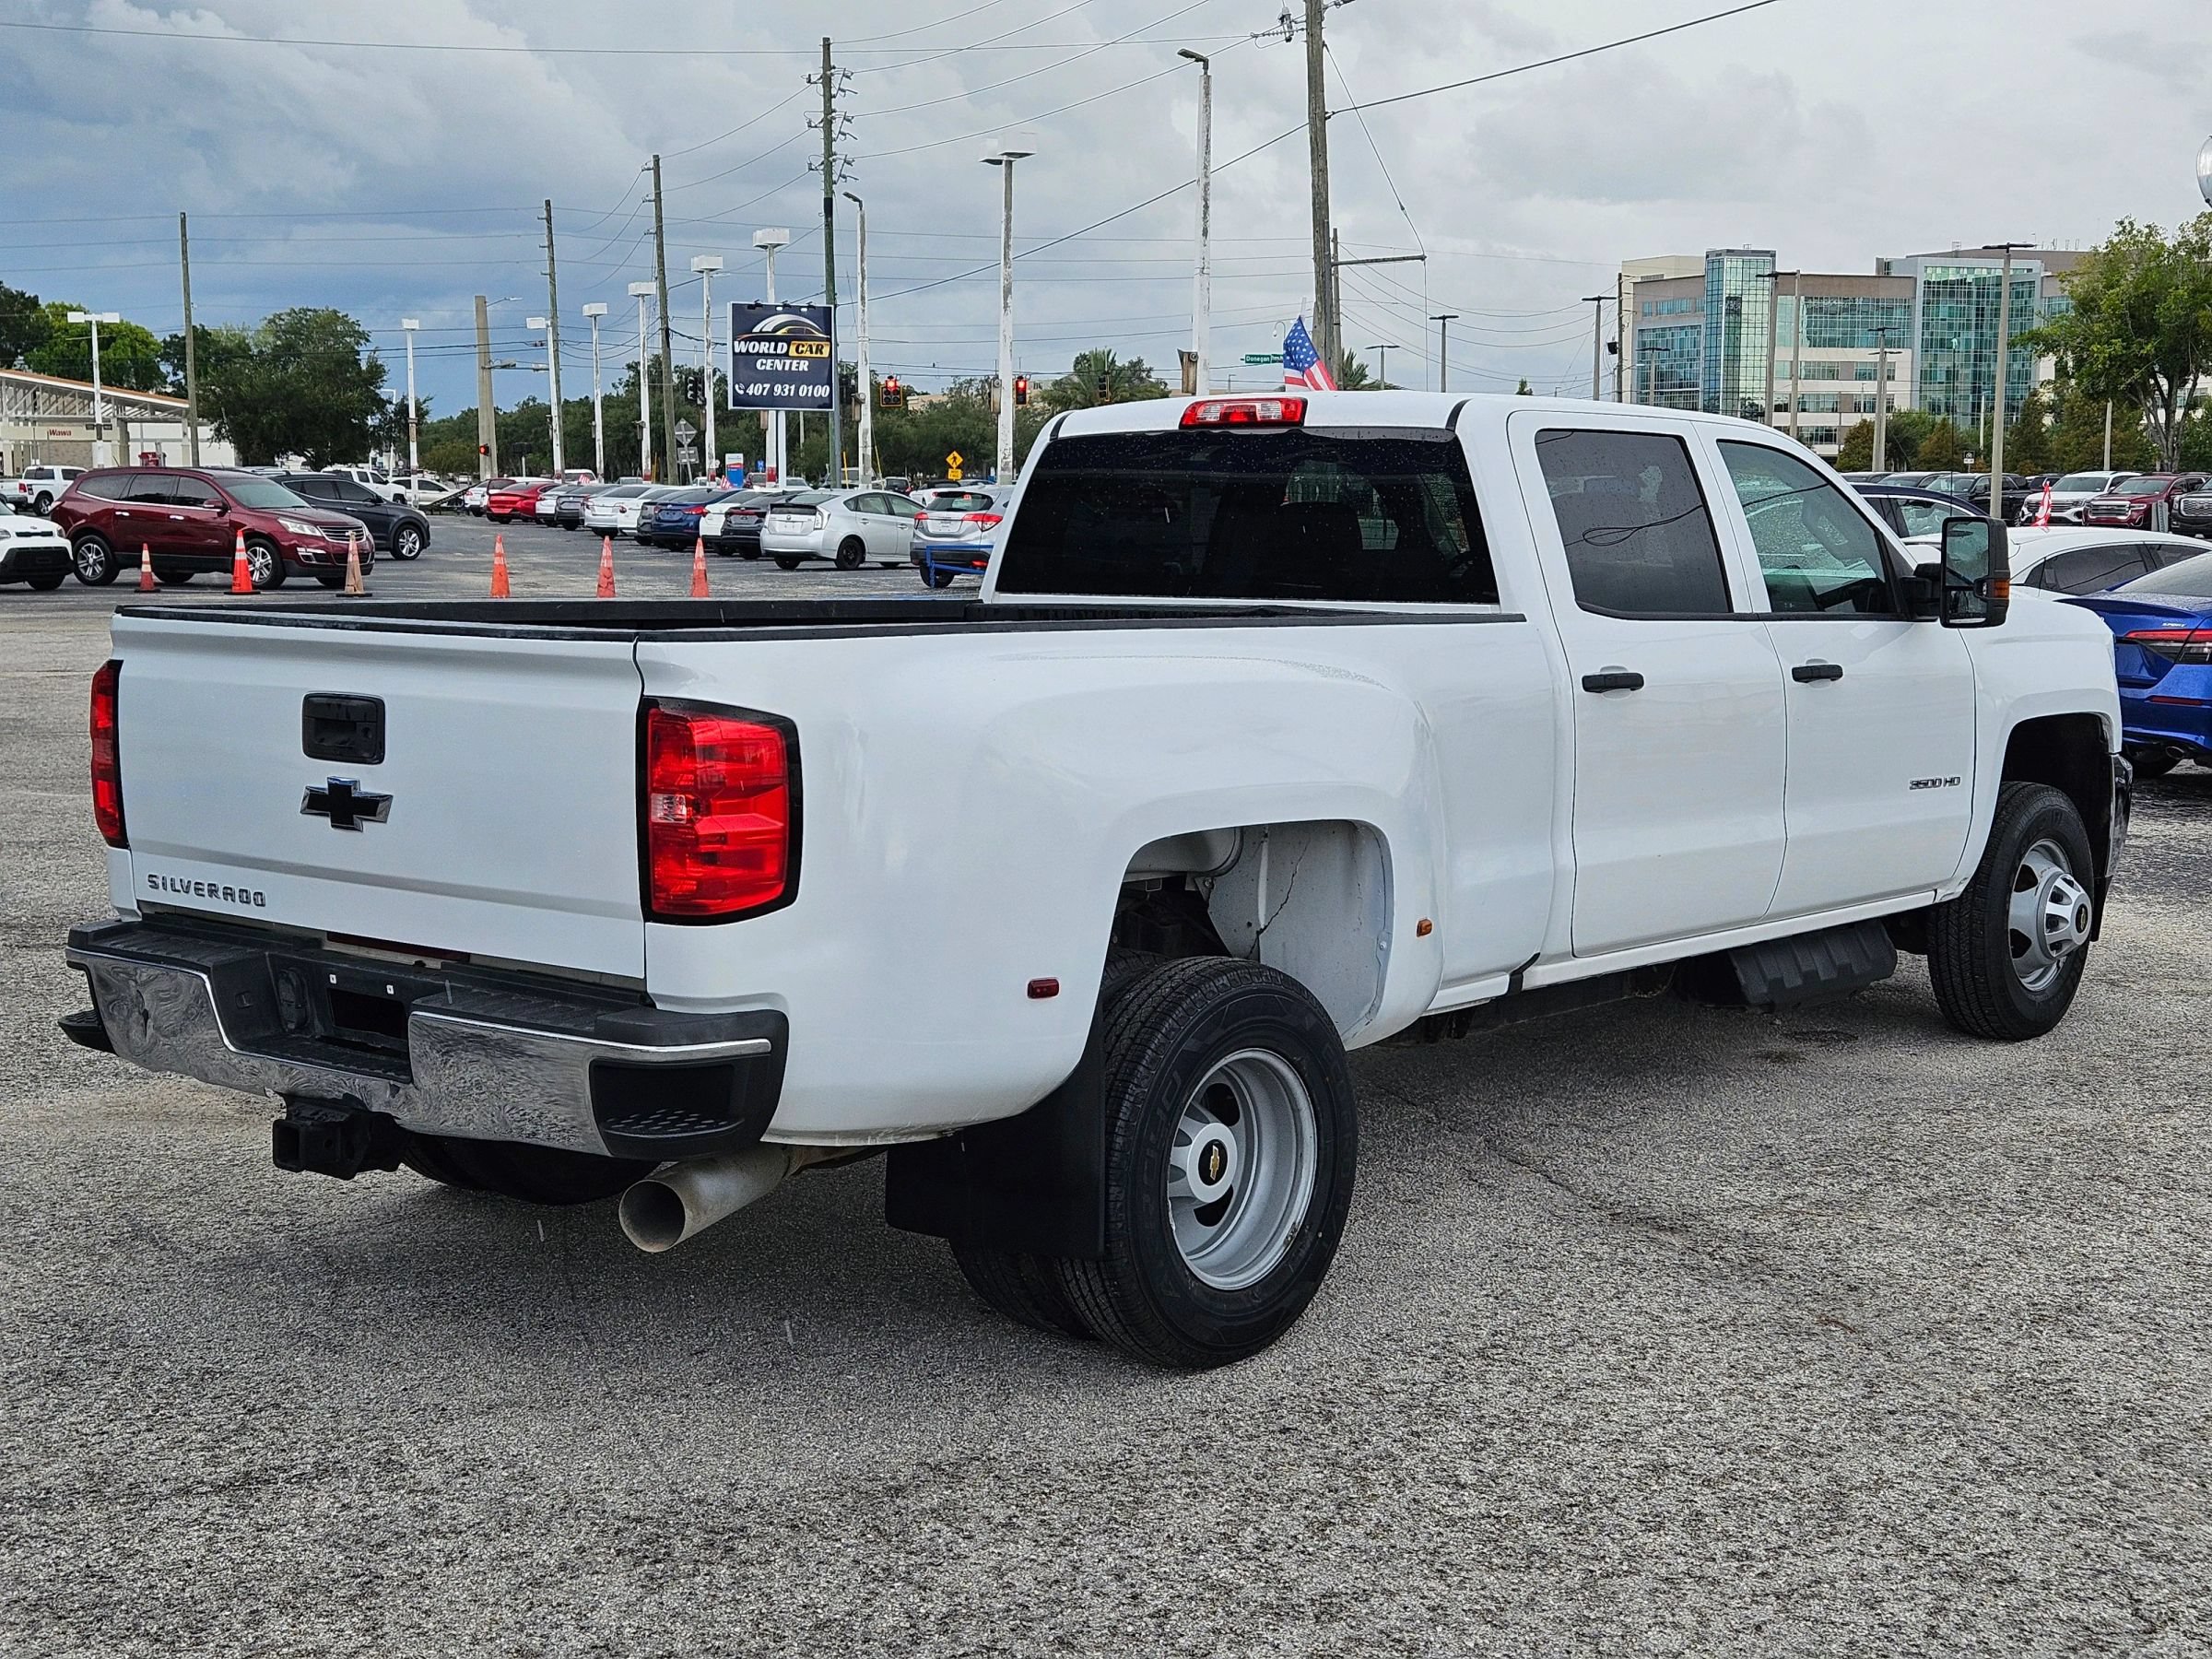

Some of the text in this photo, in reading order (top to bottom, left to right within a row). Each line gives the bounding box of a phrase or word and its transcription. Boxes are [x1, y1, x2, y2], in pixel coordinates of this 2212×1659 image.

[734, 340, 824, 355] WORLD CAR
[756, 359, 809, 371] CENTER
[747, 382, 830, 397] 407 931 0100
[1909, 776, 1961, 790] 3500 HD
[147, 874, 266, 907] SILVERADO
